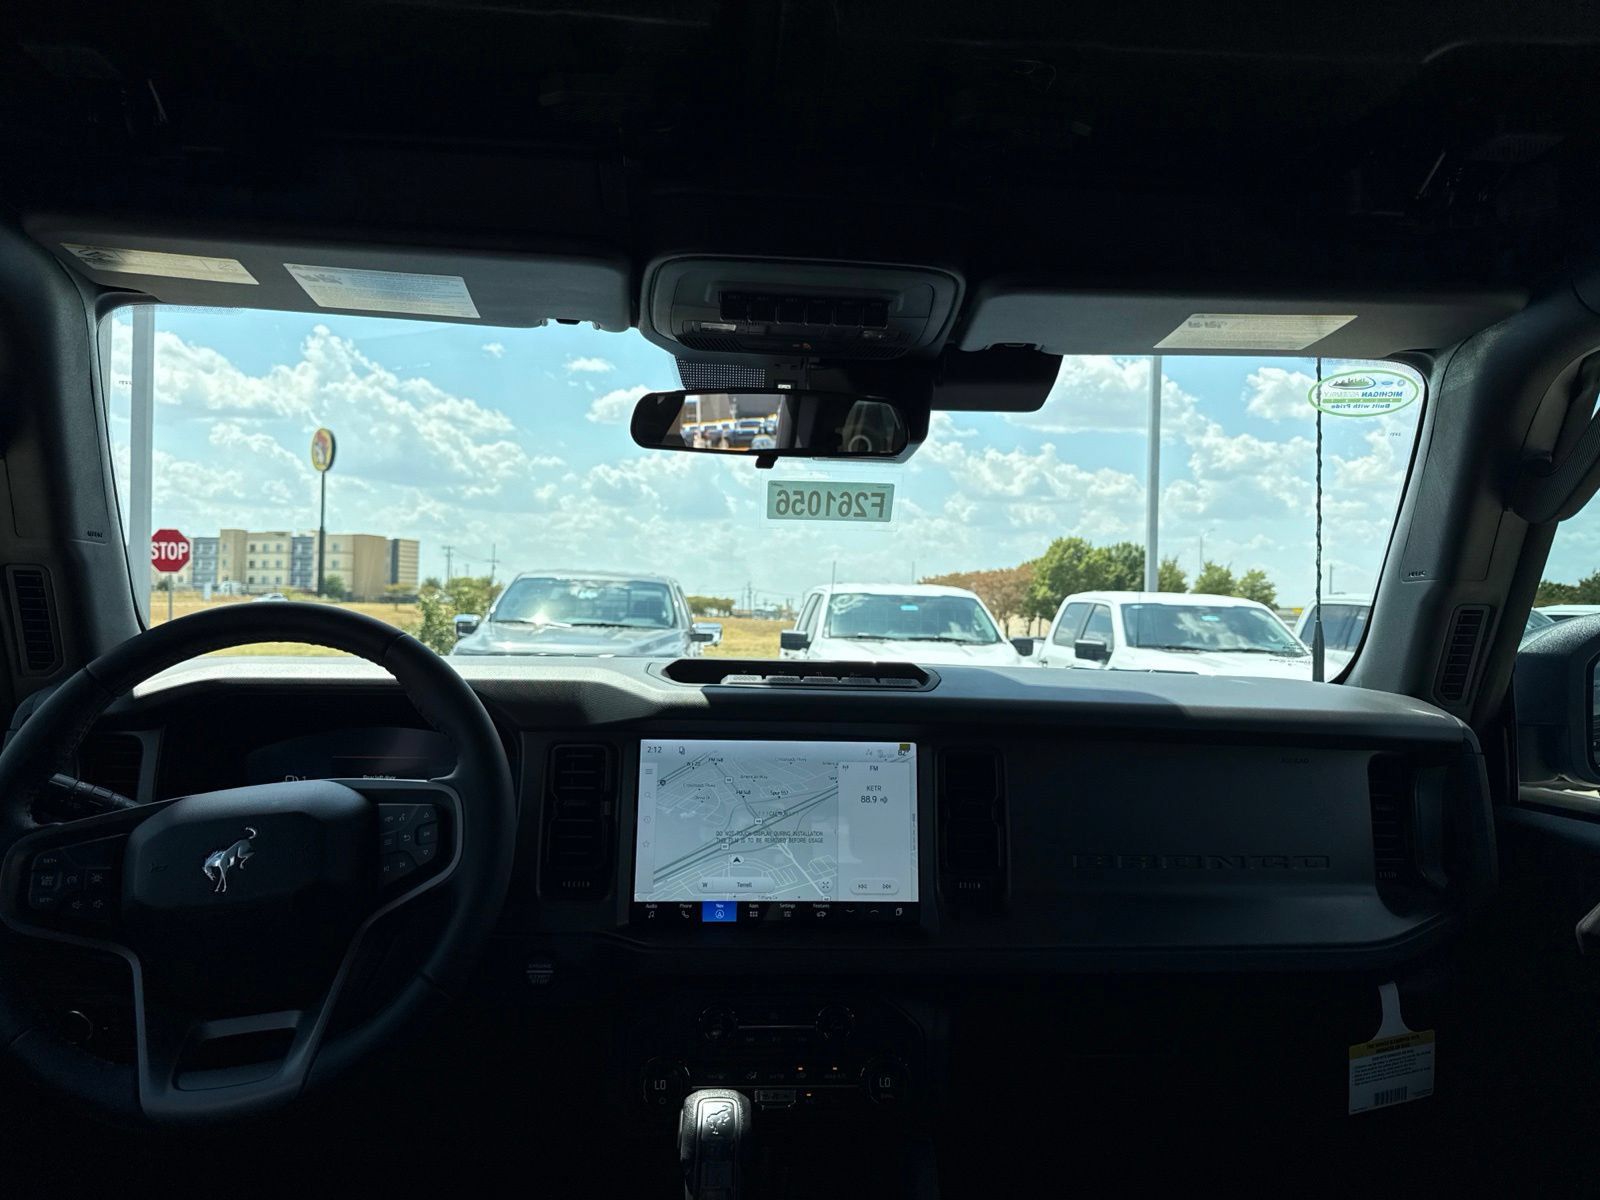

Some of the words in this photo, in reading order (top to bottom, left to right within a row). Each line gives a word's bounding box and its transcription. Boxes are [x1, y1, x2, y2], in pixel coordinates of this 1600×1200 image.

[151, 541, 189, 561] STOP
[647, 746, 662, 754] 2:12
[860, 795, 877, 804] 88.9
[654, 1079, 667, 1090] LO
[878, 1077, 891, 1088] LO
